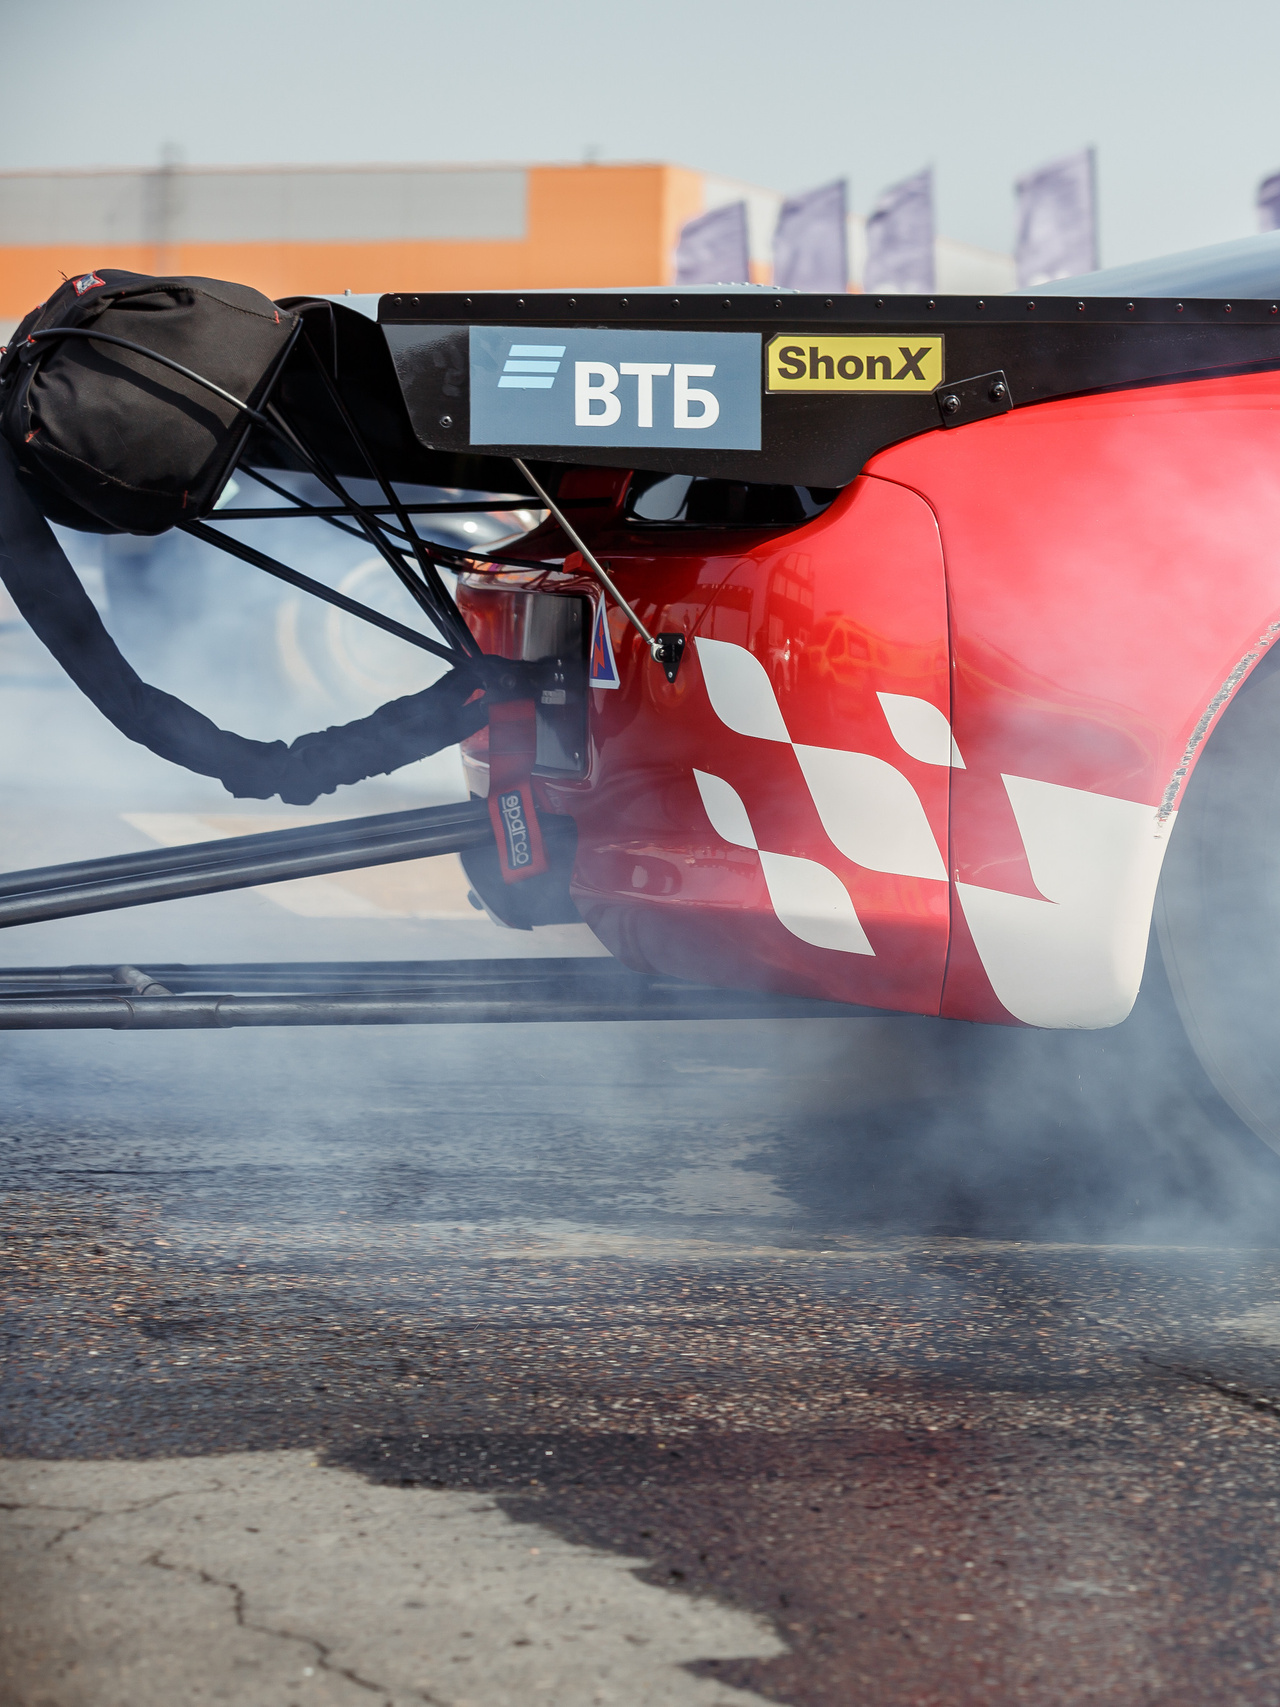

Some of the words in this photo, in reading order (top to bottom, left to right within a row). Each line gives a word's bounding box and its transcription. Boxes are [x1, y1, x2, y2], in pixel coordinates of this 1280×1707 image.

[575, 361, 720, 429] ВТБ
[777, 346, 933, 381] ShonX
[502, 795, 529, 865] sparco
